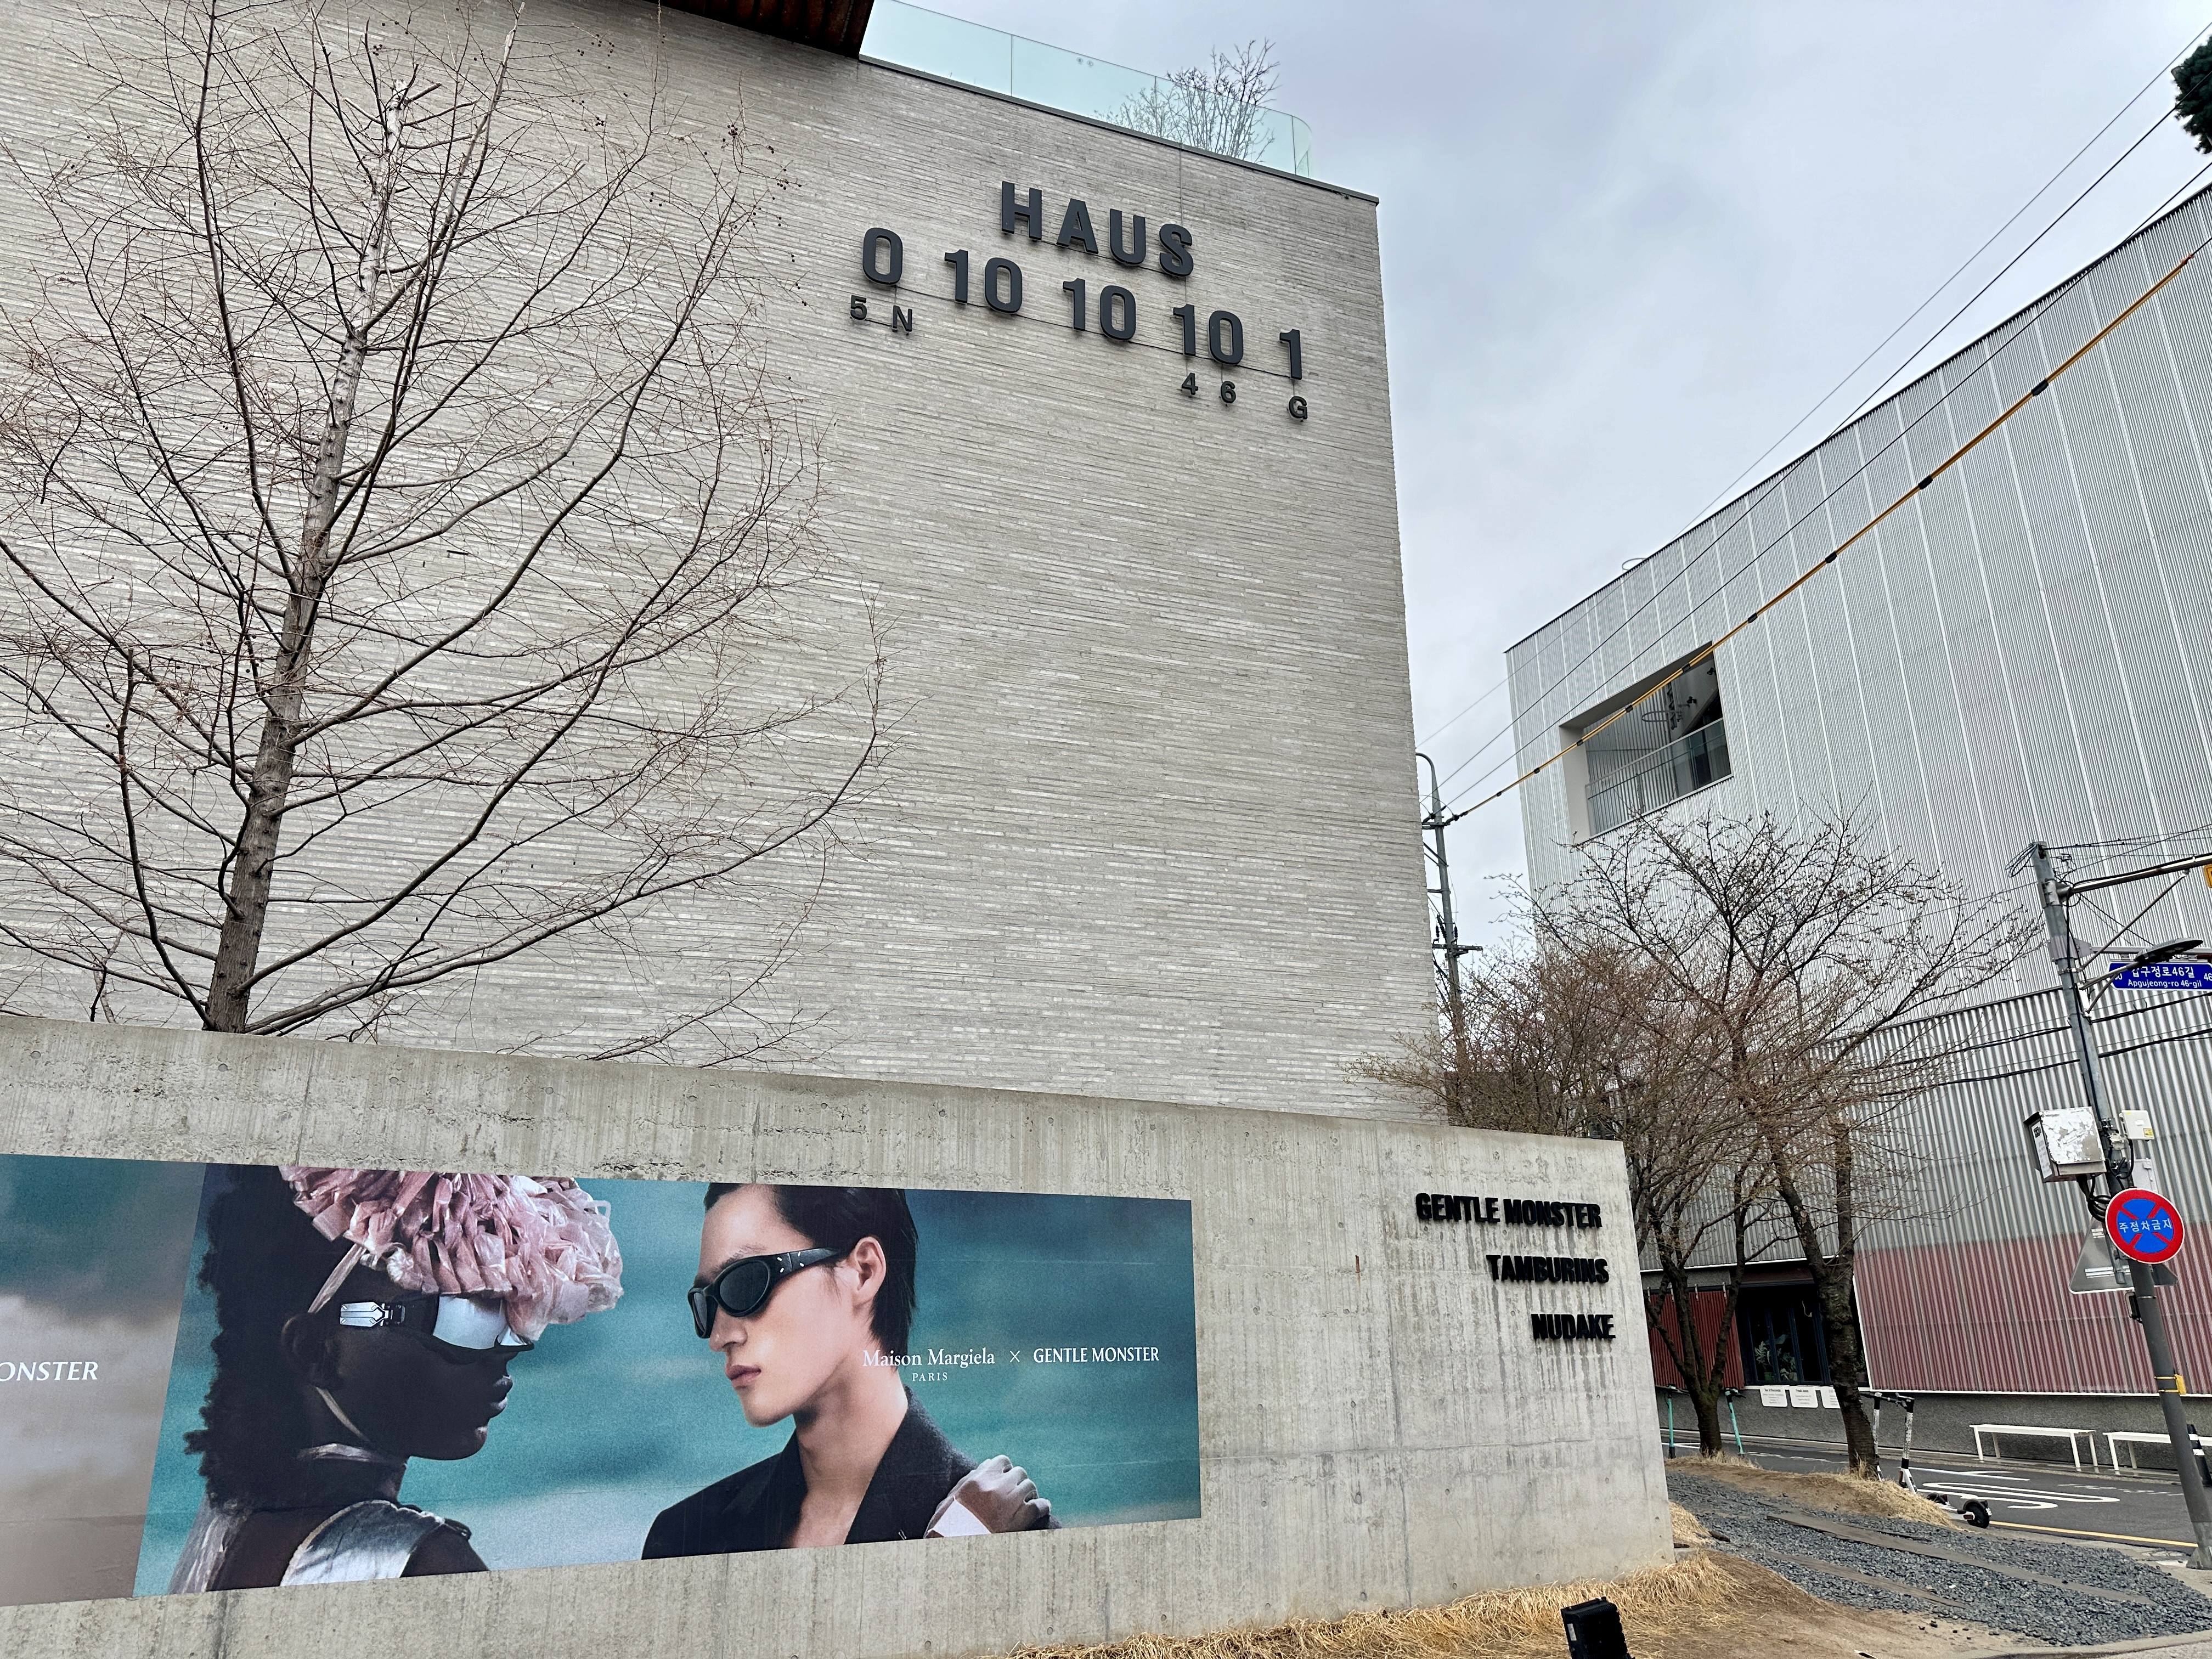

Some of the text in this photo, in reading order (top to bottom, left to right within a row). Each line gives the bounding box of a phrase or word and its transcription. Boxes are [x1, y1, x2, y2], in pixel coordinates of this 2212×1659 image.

[1002, 180, 1194, 277] HAUS
[862, 227, 1302, 380] 0 10 10 10 1
[850, 295, 1308, 420] 5 N 4 6 G
[2128, 979, 2202, 989] Apgujeong-ro 46-gil
[1415, 1193, 1602, 1228] GENTLE MONSTER
[2119, 1218, 2172, 1233] 주정차금지
[1486, 1254, 1610, 1283] TAMBURINS
[1531, 1313, 1616, 1340] NUDAKE
[862, 1350, 922, 1367] Maison
[927, 1347, 995, 1369] Margiela
[1032, 1347, 1088, 1364] GENTLE
[1091, 1346, 1160, 1363] MONSTER
[911, 1372, 949, 1383] PARIS
